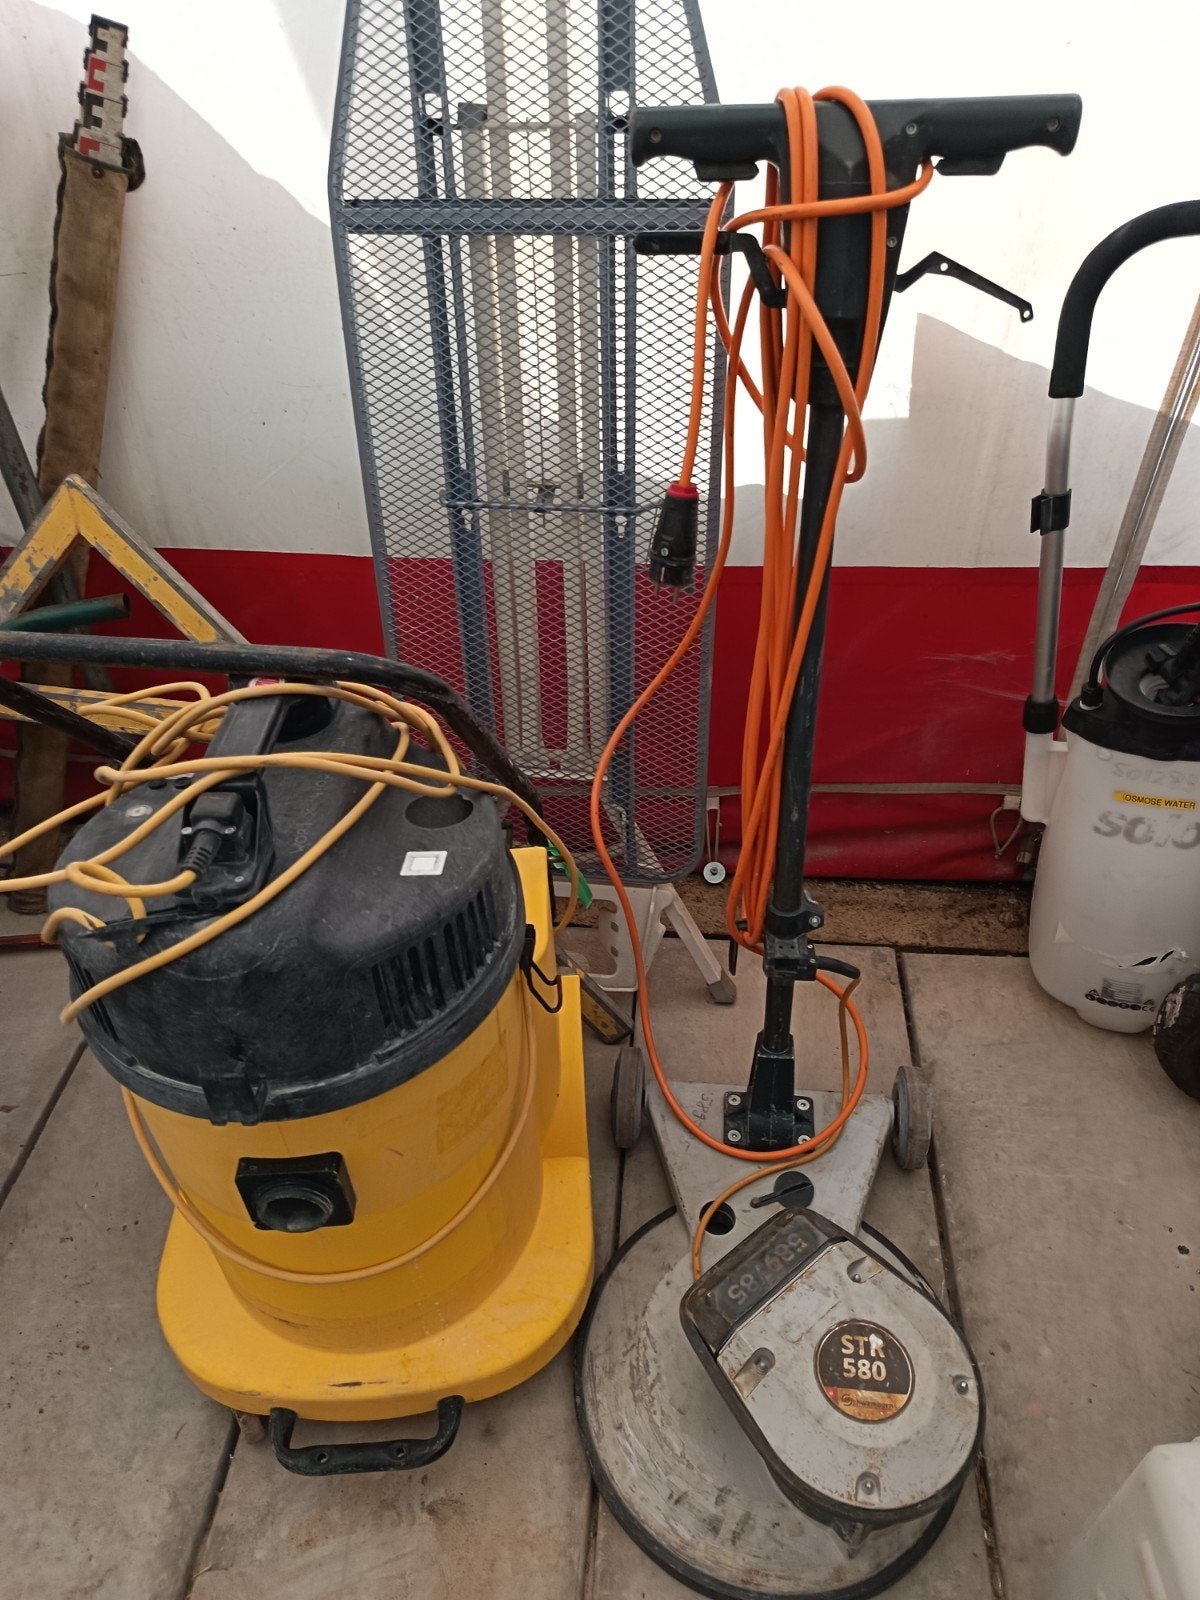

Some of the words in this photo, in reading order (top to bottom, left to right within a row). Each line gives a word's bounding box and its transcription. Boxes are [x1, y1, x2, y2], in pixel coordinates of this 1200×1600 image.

[1124, 794, 1162, 807] OSMOSE
[1164, 800, 1196, 810] WATER
[840, 1333, 886, 1358] STR
[843, 1357, 887, 1382] 580
